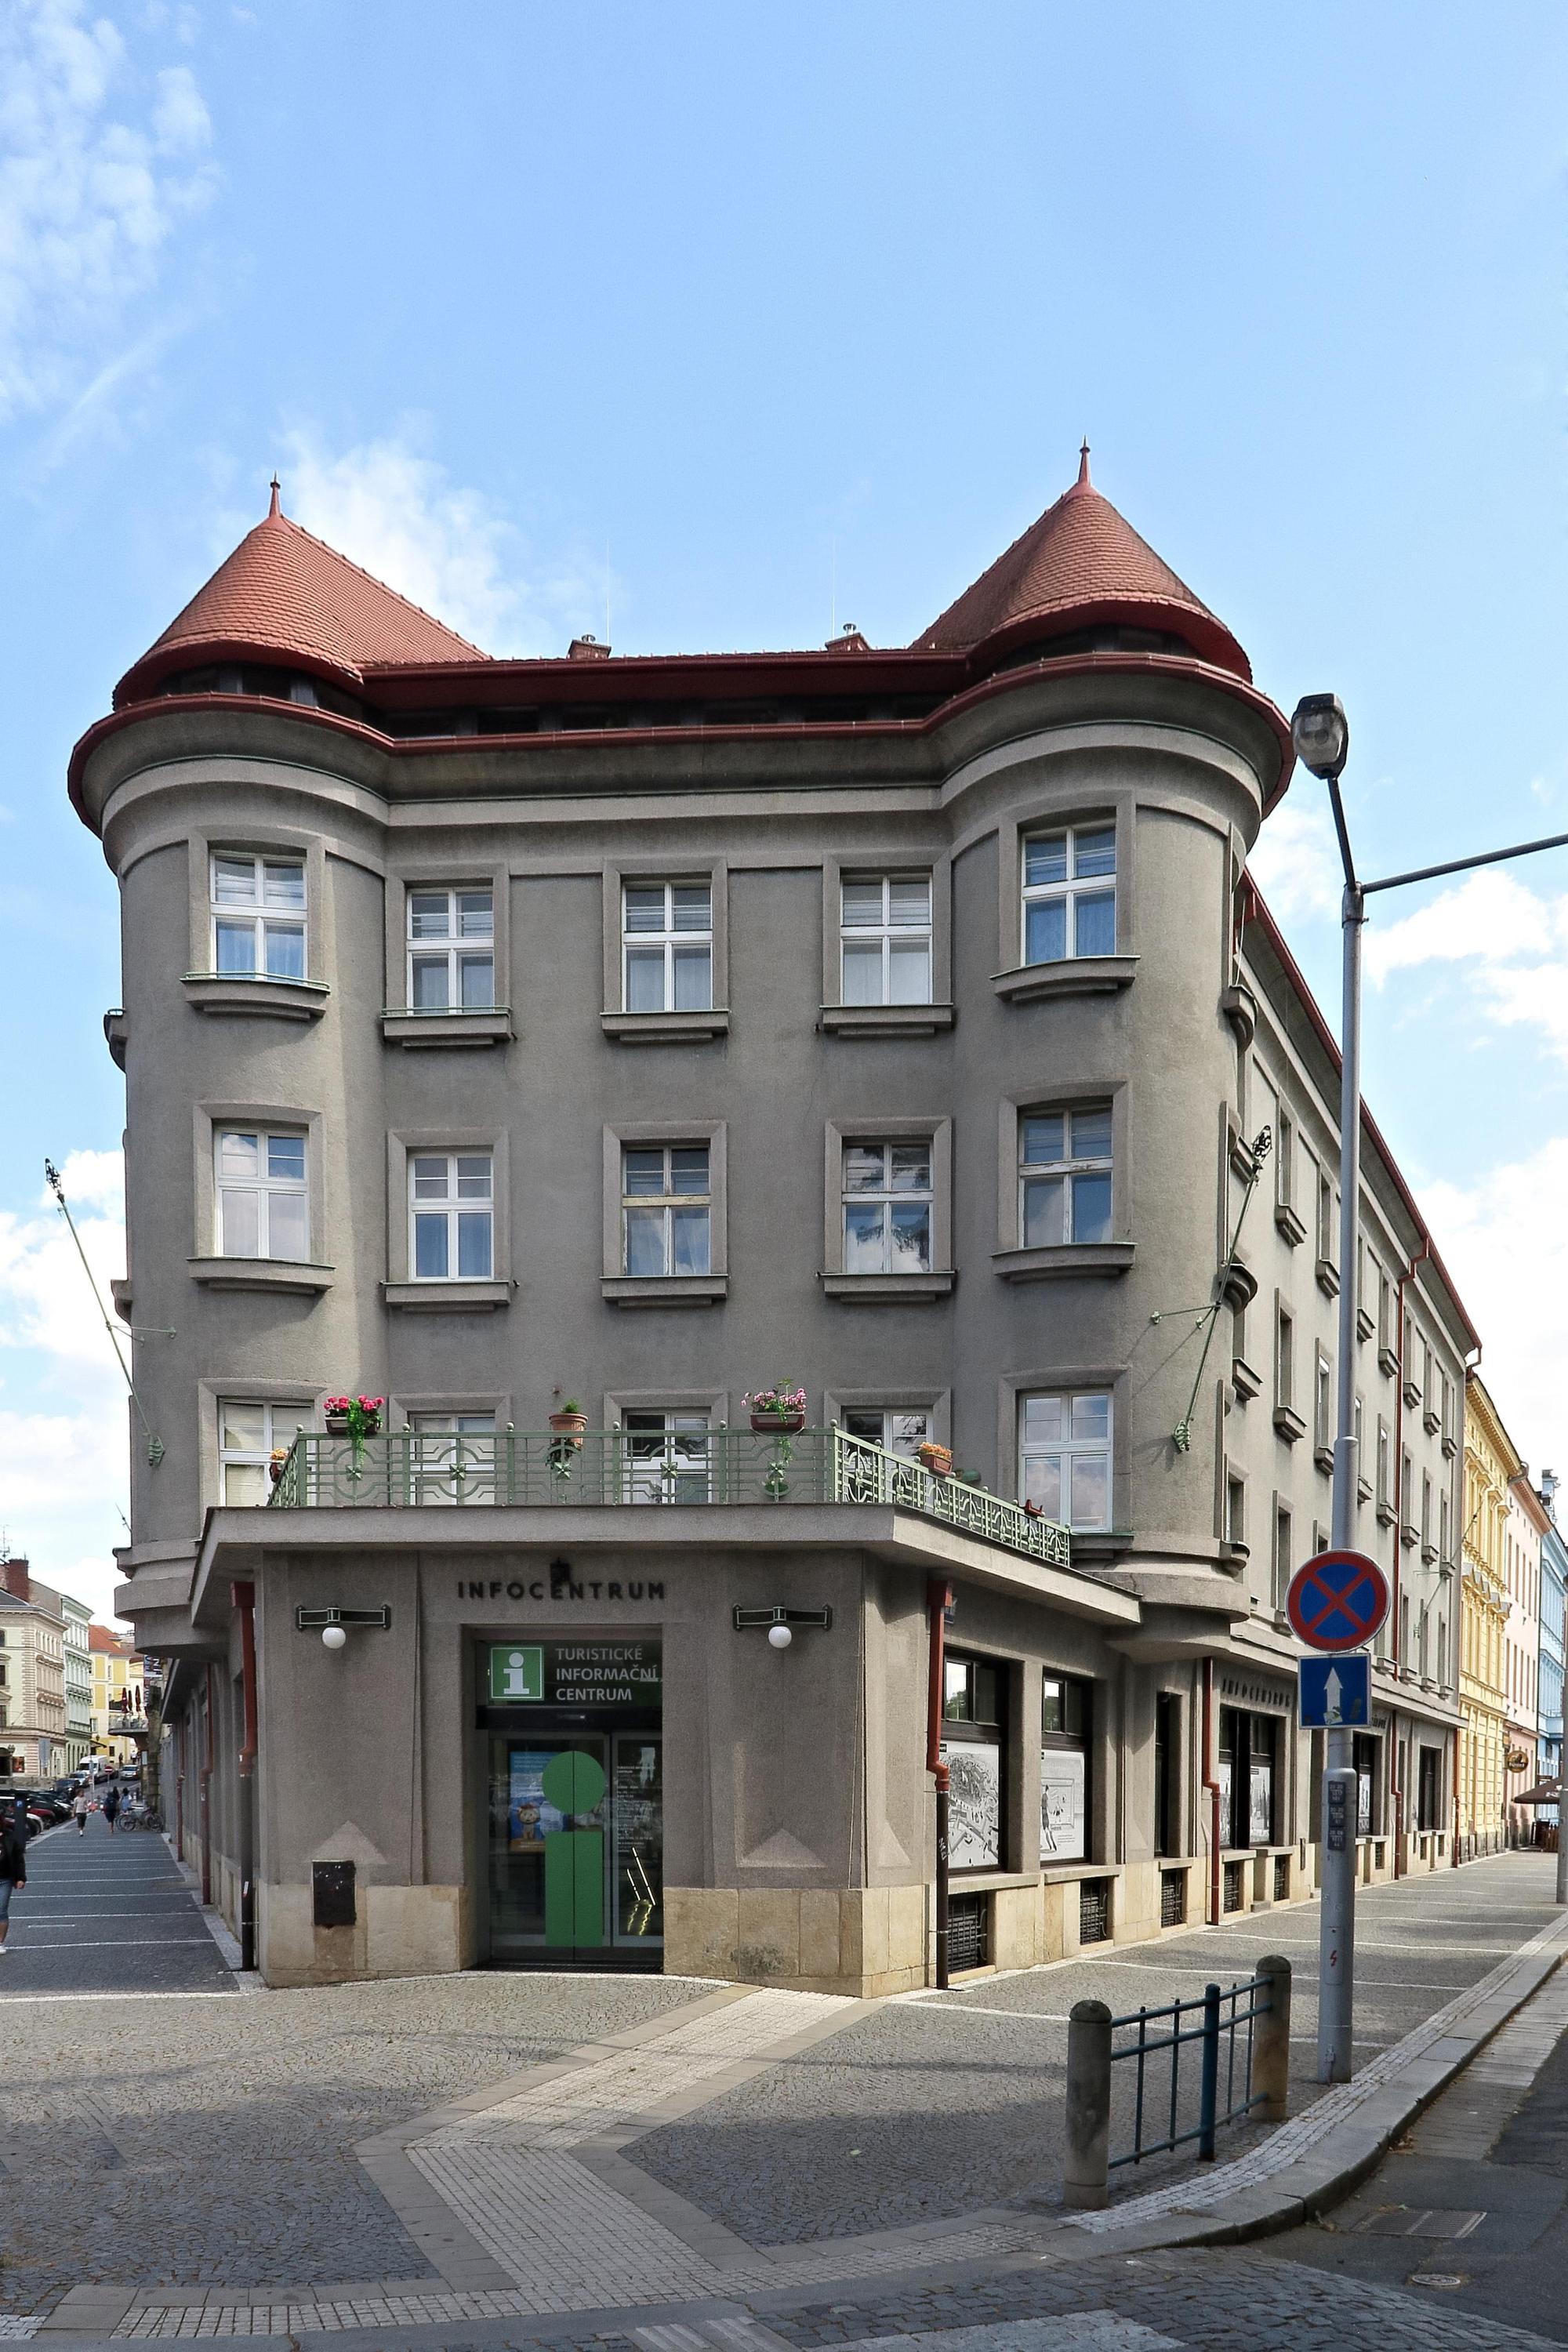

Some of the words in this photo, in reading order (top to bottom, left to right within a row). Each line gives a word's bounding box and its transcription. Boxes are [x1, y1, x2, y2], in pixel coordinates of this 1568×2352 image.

[458, 1581, 665, 1599] INFOCENTRUM
[556, 1644, 643, 1661] TURISTICKÉ
[556, 1664, 658, 1681] INFORMAČNÍ
[556, 1687, 632, 1700] CENTRUM
